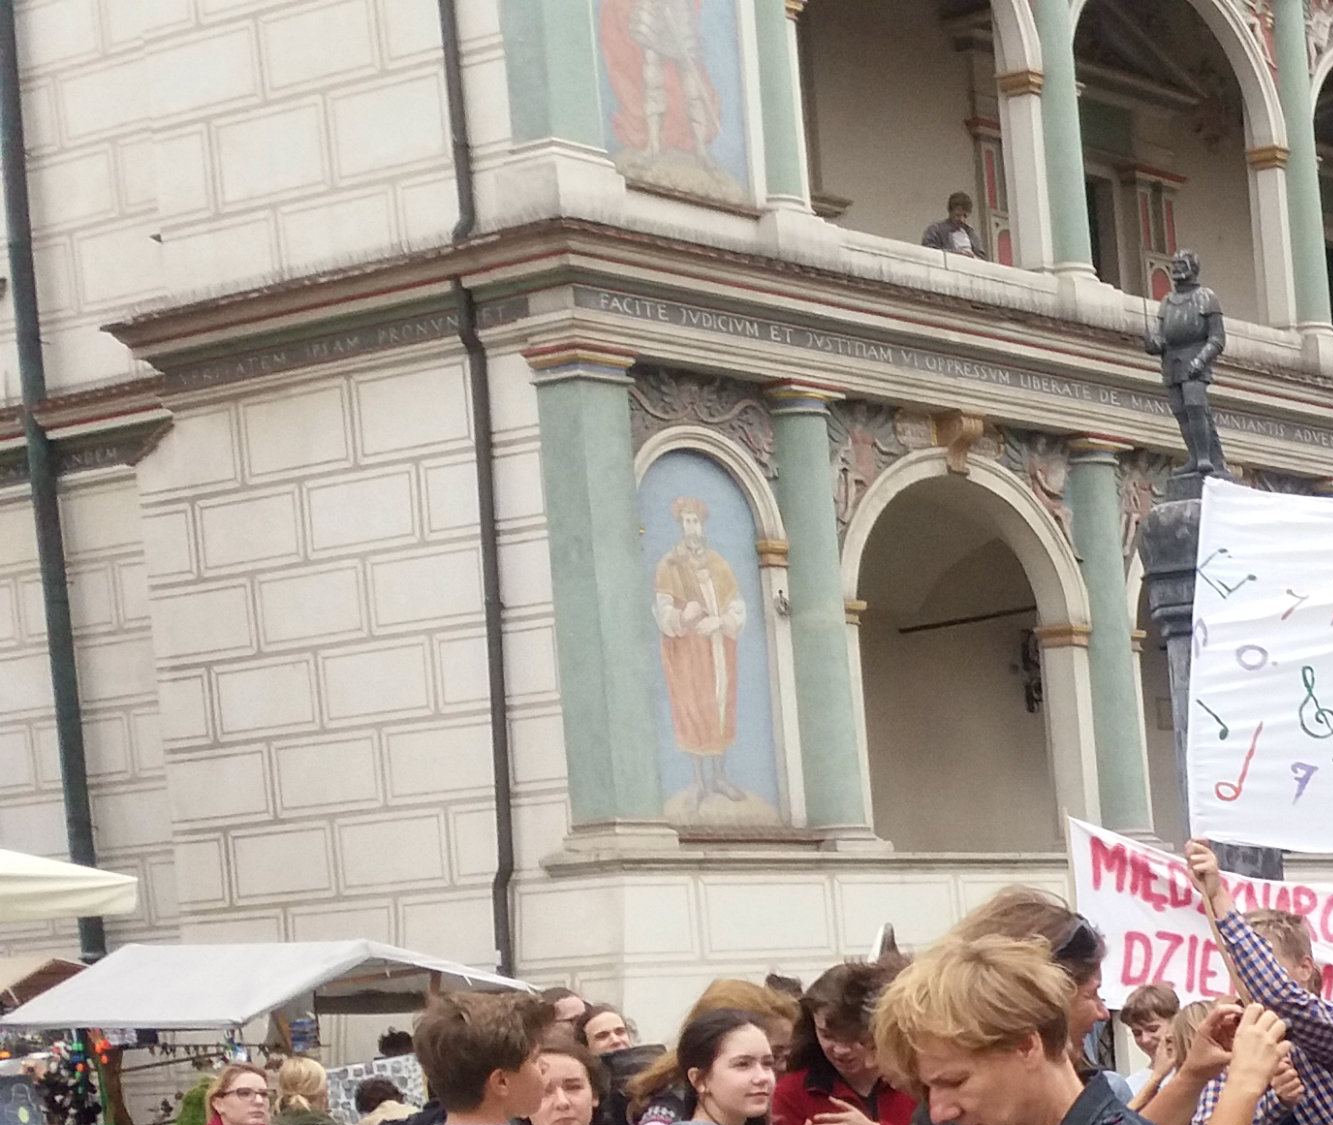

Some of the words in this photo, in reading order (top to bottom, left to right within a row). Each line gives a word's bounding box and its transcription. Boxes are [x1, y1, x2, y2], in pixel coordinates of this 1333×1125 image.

[600, 293, 670, 321] FACITE
[770, 325, 794, 343] ET
[901, 350, 918, 367] VI
[925, 355, 1010, 384] OPPRESSVM
[1019, 373, 1092, 400] LIBERATE
[1101, 389, 1121, 406] DE
